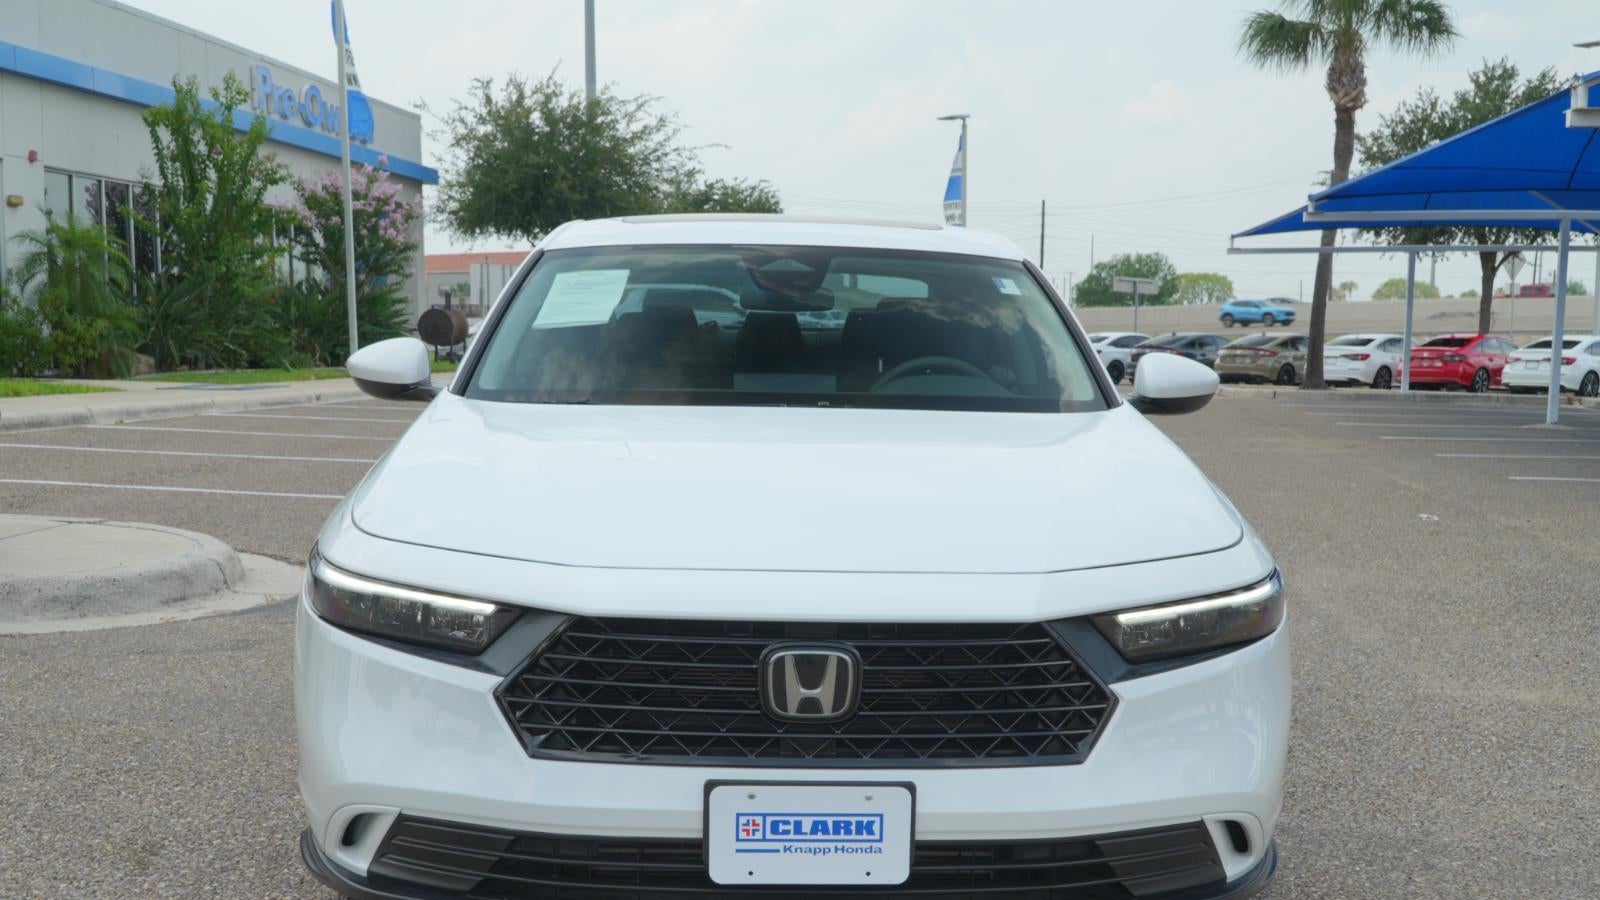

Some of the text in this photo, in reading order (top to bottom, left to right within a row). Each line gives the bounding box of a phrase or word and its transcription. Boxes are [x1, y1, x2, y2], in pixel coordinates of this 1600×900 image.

[769, 819, 876, 836] CLARK
[783, 845, 882, 856] Knapp Honda
